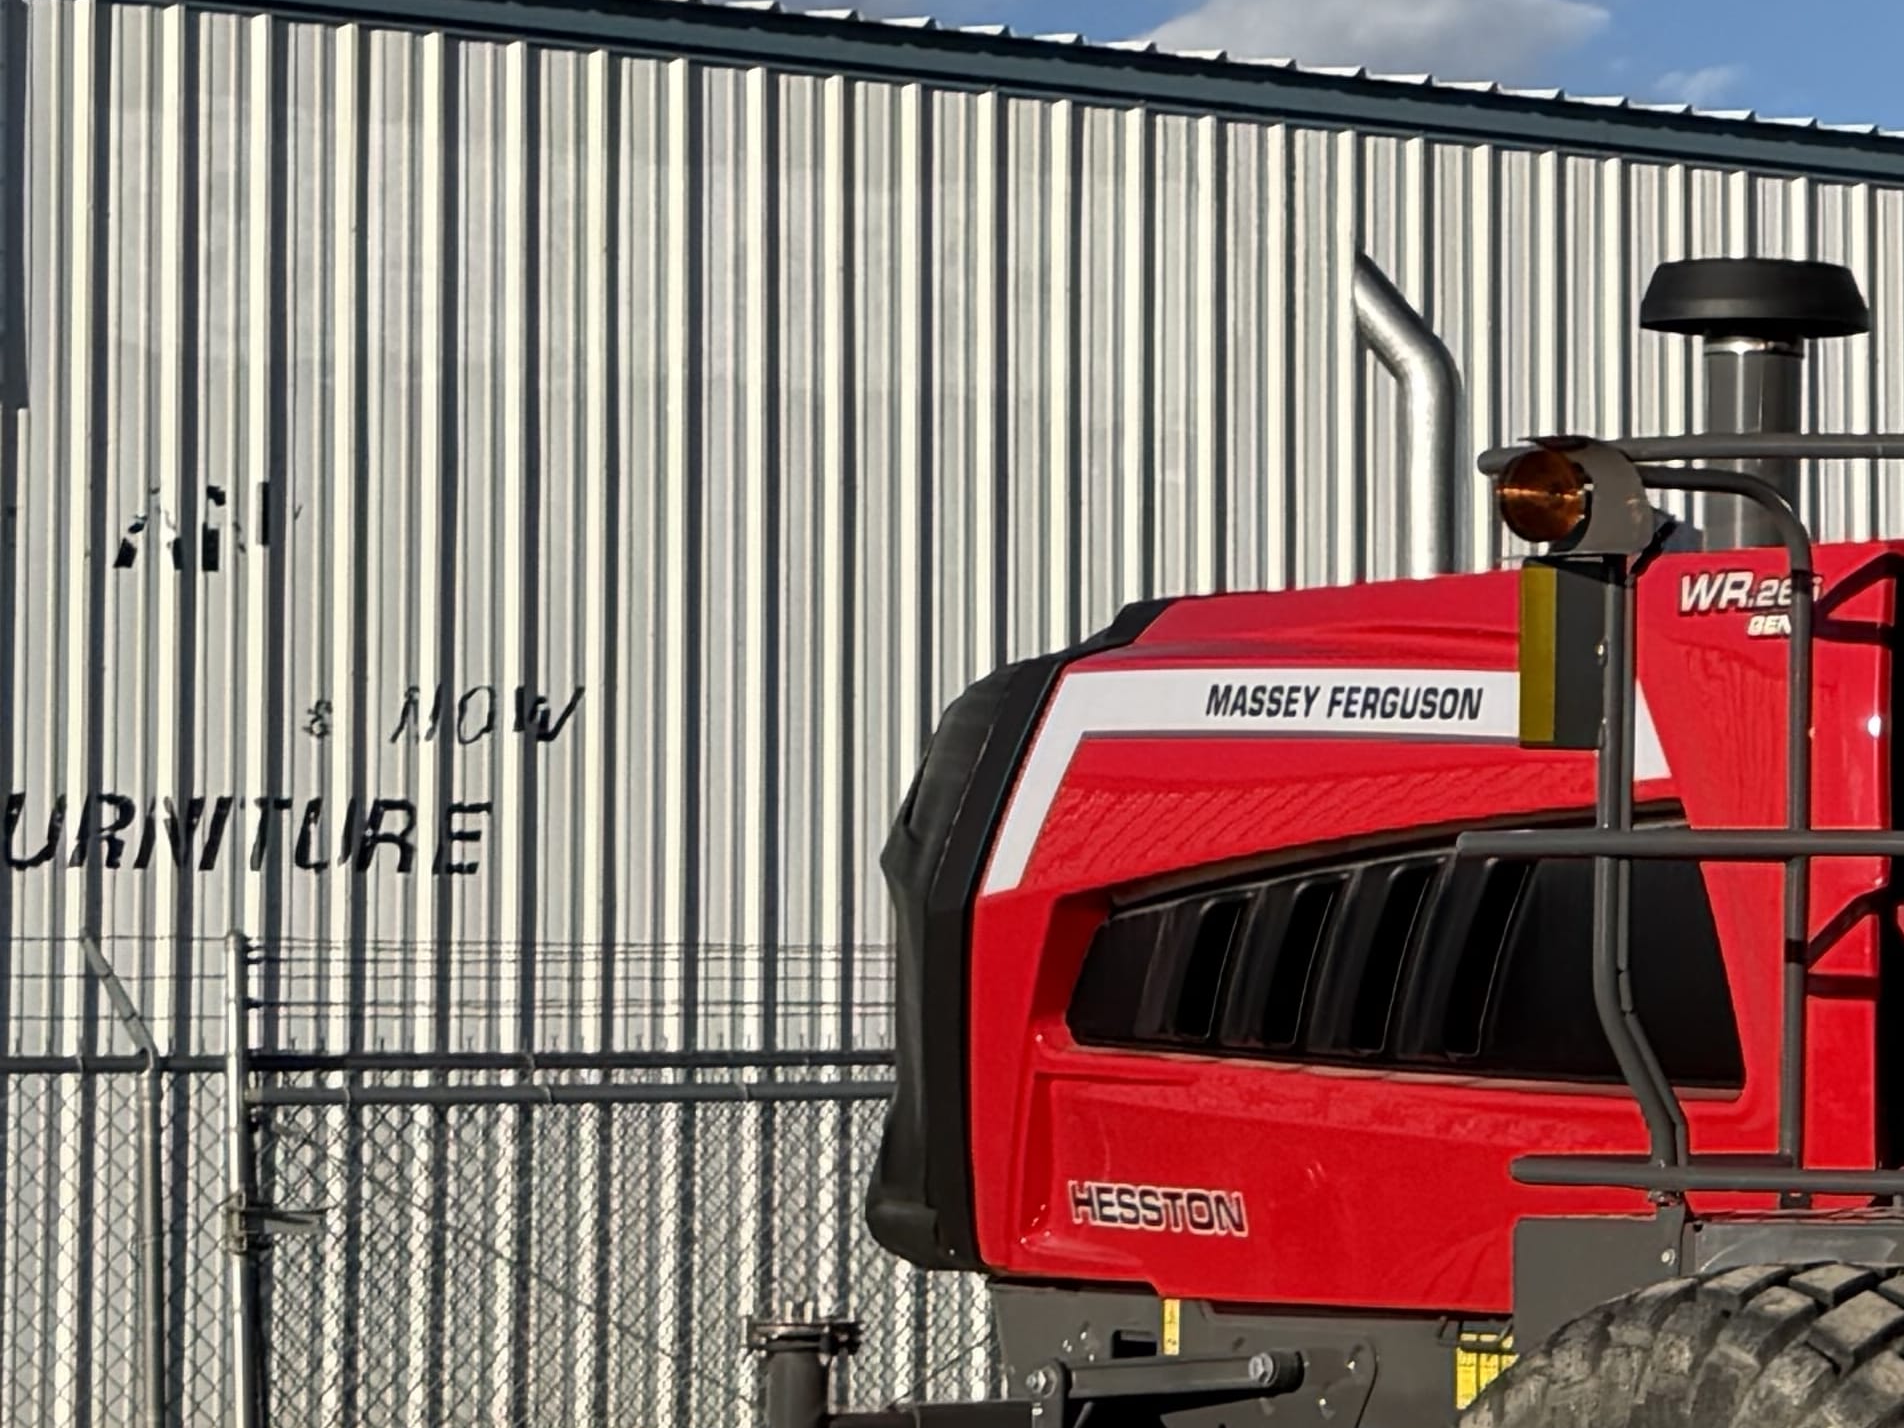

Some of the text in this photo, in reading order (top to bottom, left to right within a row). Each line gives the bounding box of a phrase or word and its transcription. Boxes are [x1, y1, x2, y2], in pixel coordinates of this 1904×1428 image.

[1205, 684, 1483, 721] MASSEY FERGUSON
[3, 792, 493, 875] URNITURE
[1067, 1180, 1249, 1238] HESSTON
